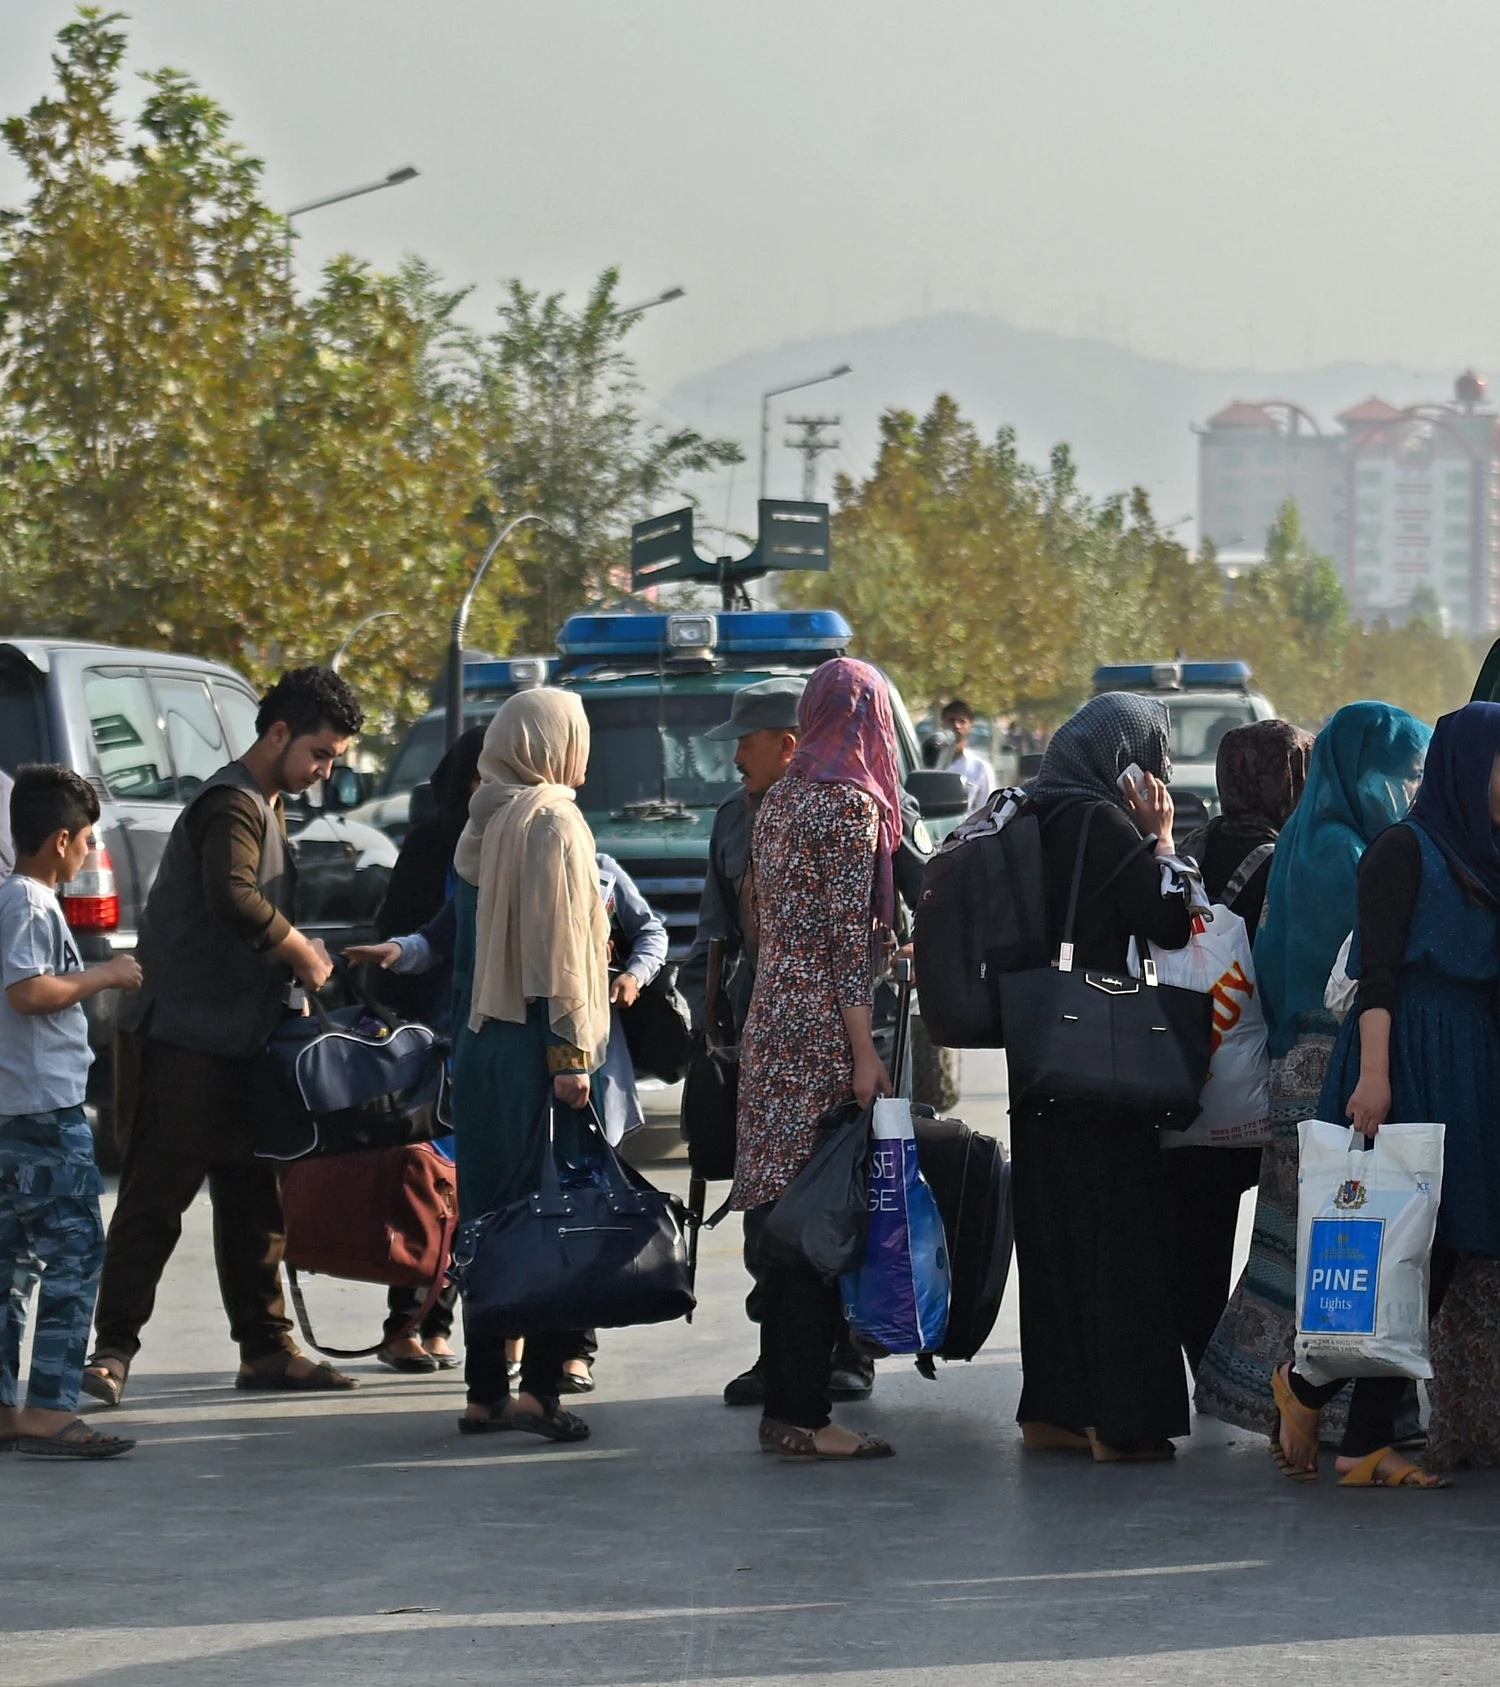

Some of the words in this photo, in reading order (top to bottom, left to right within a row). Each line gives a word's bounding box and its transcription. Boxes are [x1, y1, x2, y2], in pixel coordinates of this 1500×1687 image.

[1210, 960, 1255, 1057] UY
[868, 1151, 896, 1179] SE
[1311, 1269, 1368, 1291] PINE
[1319, 1296, 1353, 1312] Lights
